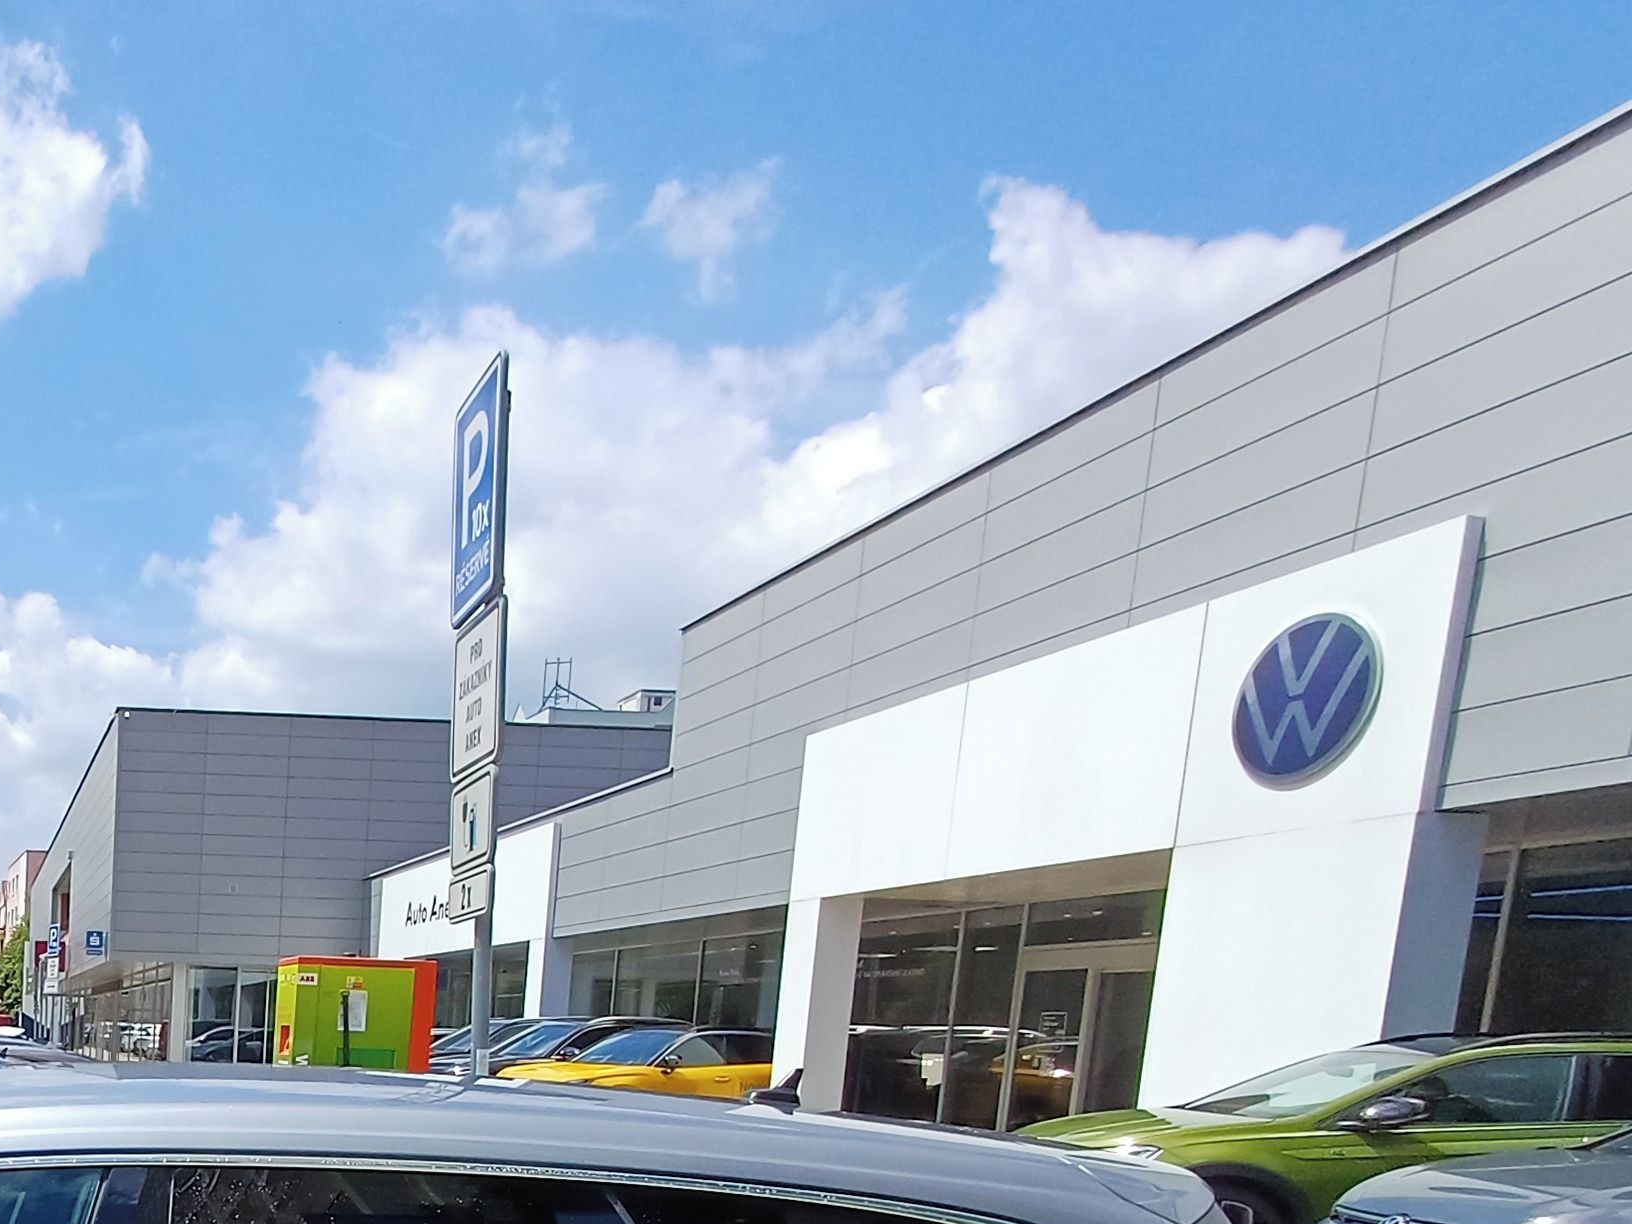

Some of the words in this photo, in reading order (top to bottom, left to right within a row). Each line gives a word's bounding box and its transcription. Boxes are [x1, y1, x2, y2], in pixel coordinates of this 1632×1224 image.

[462, 410, 488, 548] P
[470, 638, 482, 663] PRO
[466, 697, 482, 723] AUTO
[465, 725, 481, 752] ANEX
[404, 901, 427, 927] Auto
